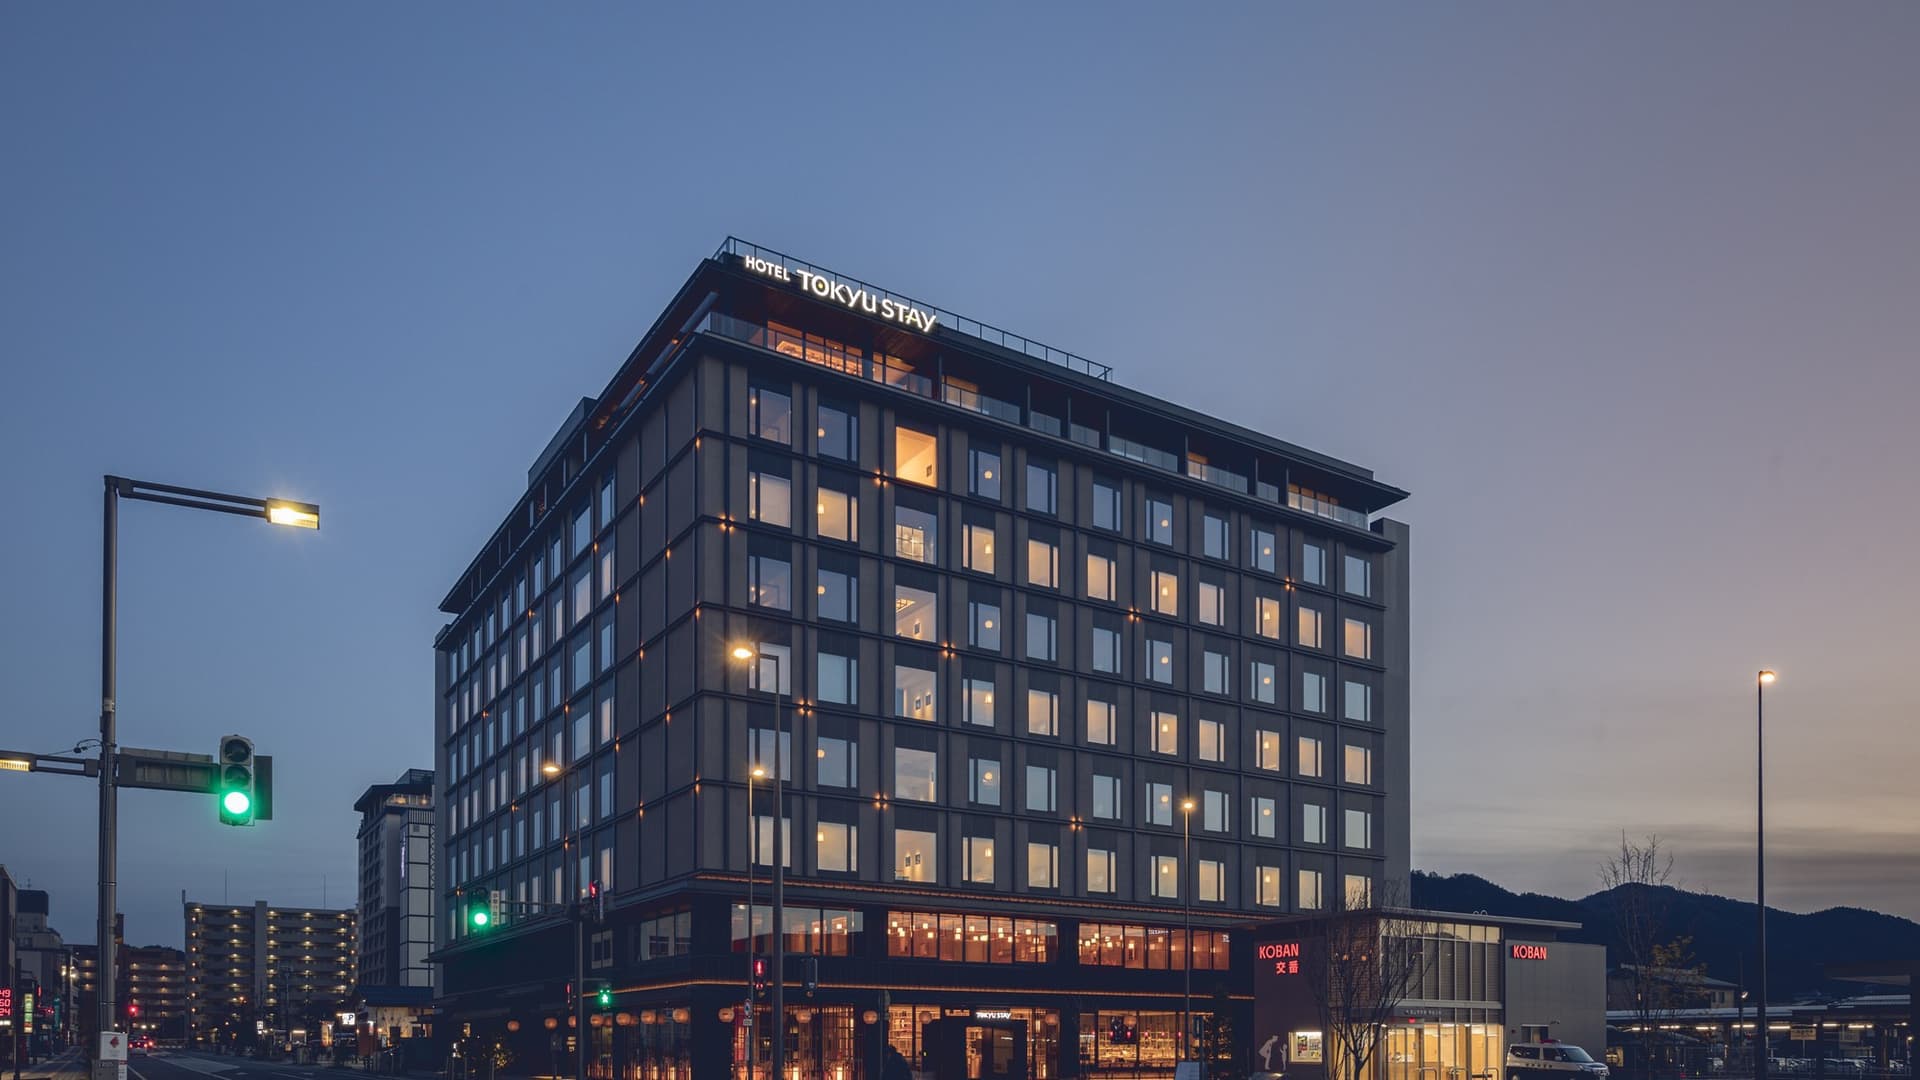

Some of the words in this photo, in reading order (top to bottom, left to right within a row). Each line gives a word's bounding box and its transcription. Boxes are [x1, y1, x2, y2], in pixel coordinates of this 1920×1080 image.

[745, 255, 791, 281] HOTEL
[796, 269, 877, 313] TOKYU
[881, 298, 937, 332] STAY
[1259, 943, 1299, 959] KOBAN
[1513, 944, 1547, 960] KOBAN
[1275, 960, 1299, 974] 交番
